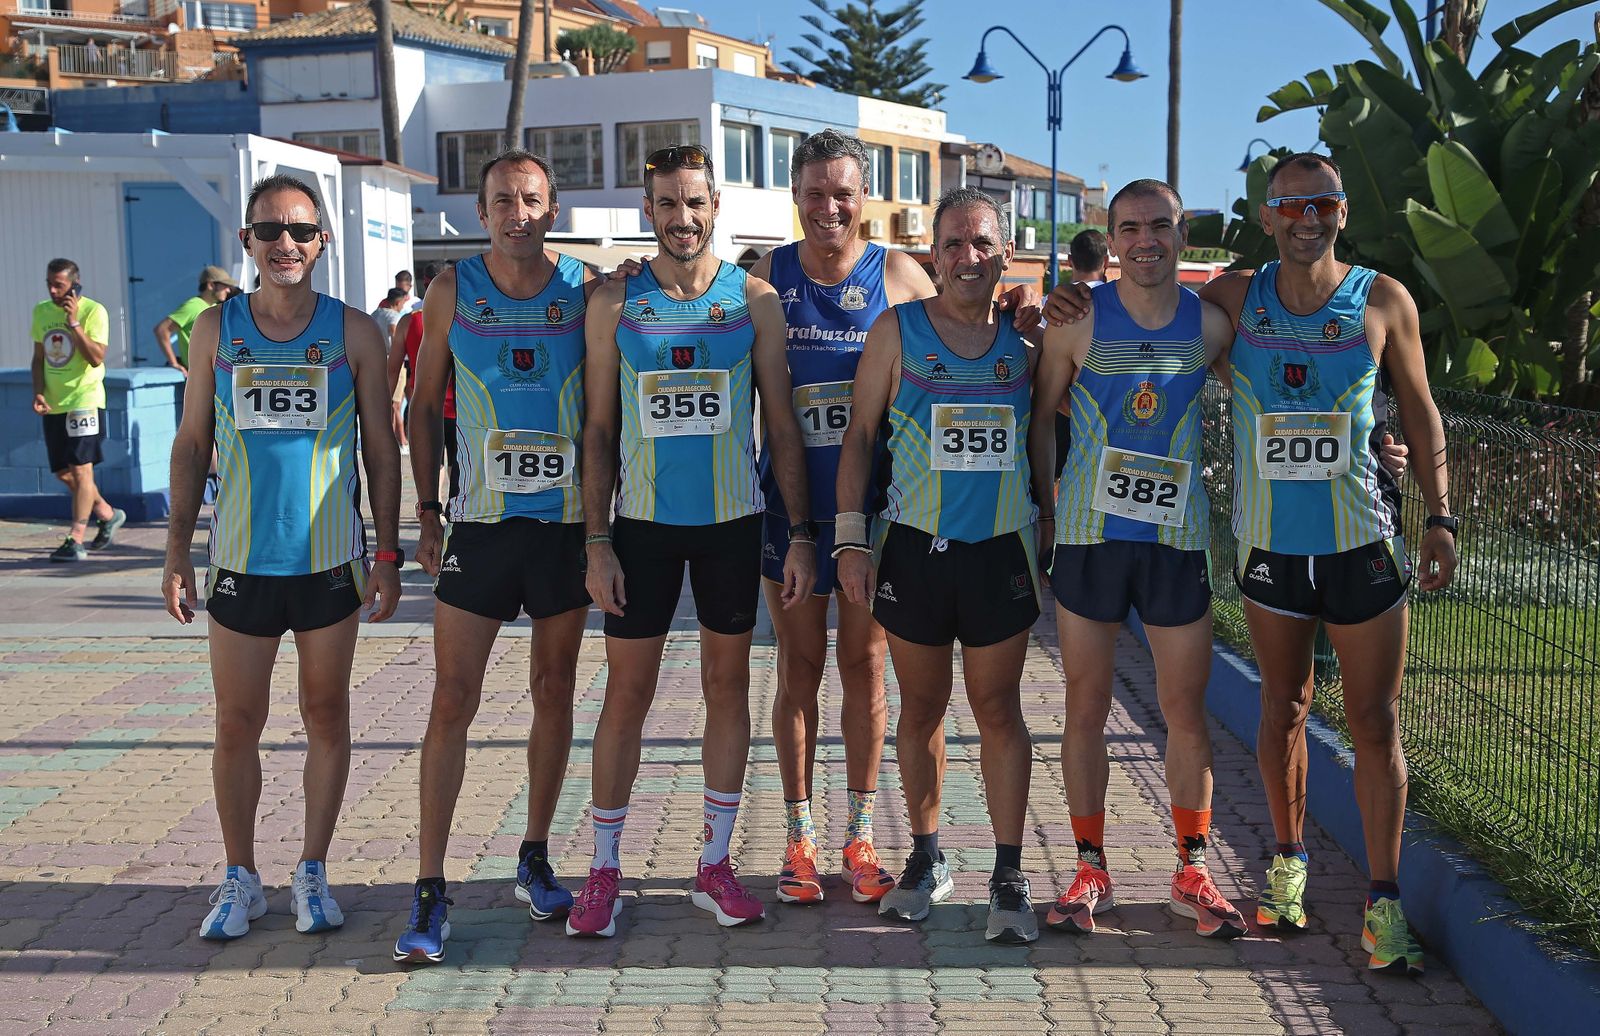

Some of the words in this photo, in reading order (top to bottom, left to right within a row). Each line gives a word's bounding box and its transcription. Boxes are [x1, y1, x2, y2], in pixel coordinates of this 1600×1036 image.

[244, 388, 317, 413] 163
[650, 393, 721, 419] 356
[69, 417, 96, 430] 348
[803, 404, 852, 431] 16
[942, 428, 1007, 453] 358
[1266, 437, 1339, 463] 200
[494, 452, 564, 478] 189
[1120, 466, 1140, 476] CIUDAD
[1147, 472, 1174, 482] ALGECIRAS
[1107, 473, 1179, 509] 382
